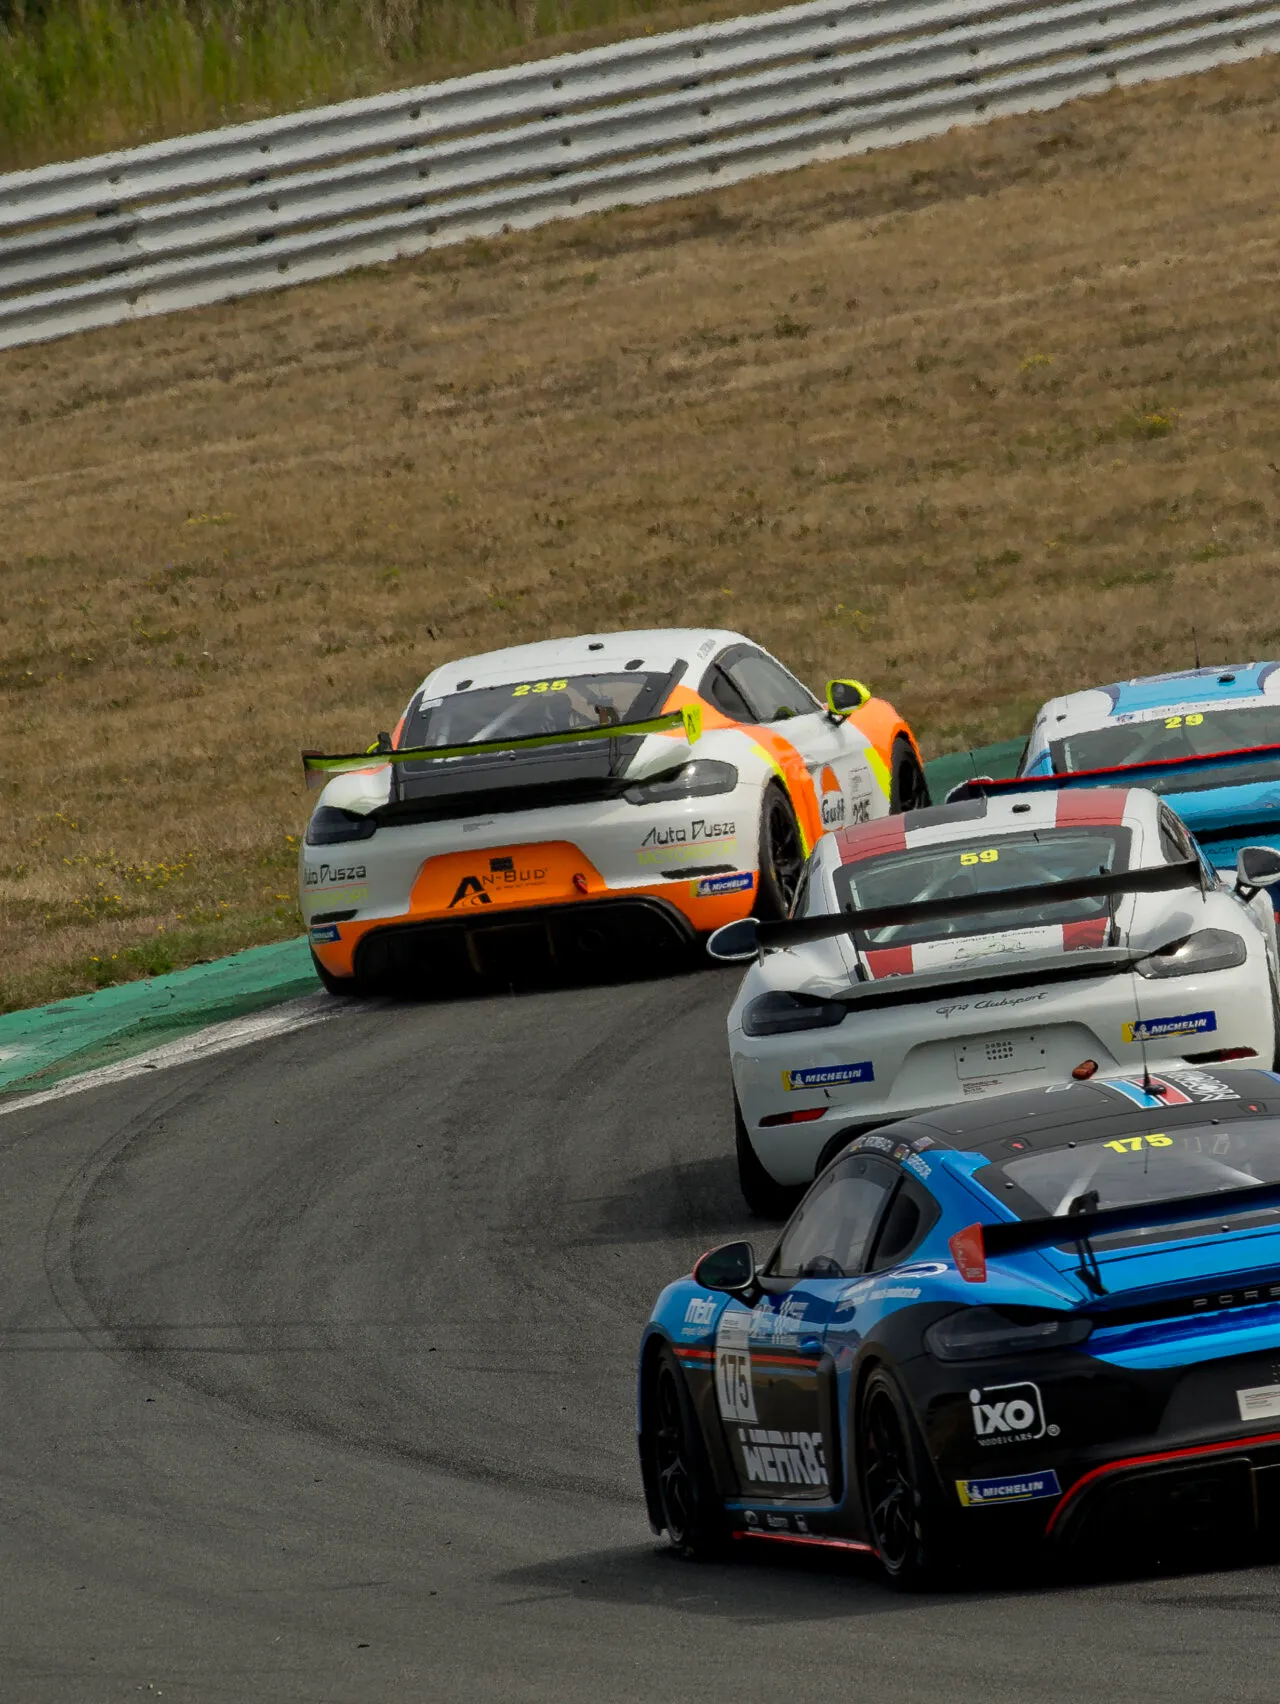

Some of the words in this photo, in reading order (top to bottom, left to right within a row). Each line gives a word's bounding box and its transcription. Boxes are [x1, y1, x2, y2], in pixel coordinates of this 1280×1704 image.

[512, 679, 568, 697] 235
[1165, 713, 1204, 729] 29
[960, 849, 999, 866] 59
[974, 992, 1049, 1011] Clubsport
[1150, 1018, 1207, 1034] MICHELIN
[804, 1069, 862, 1083] MICHELIN
[1102, 1133, 1174, 1154] 175
[719, 1353, 749, 1409] 175
[982, 1480, 1045, 1498] MICHELIN
